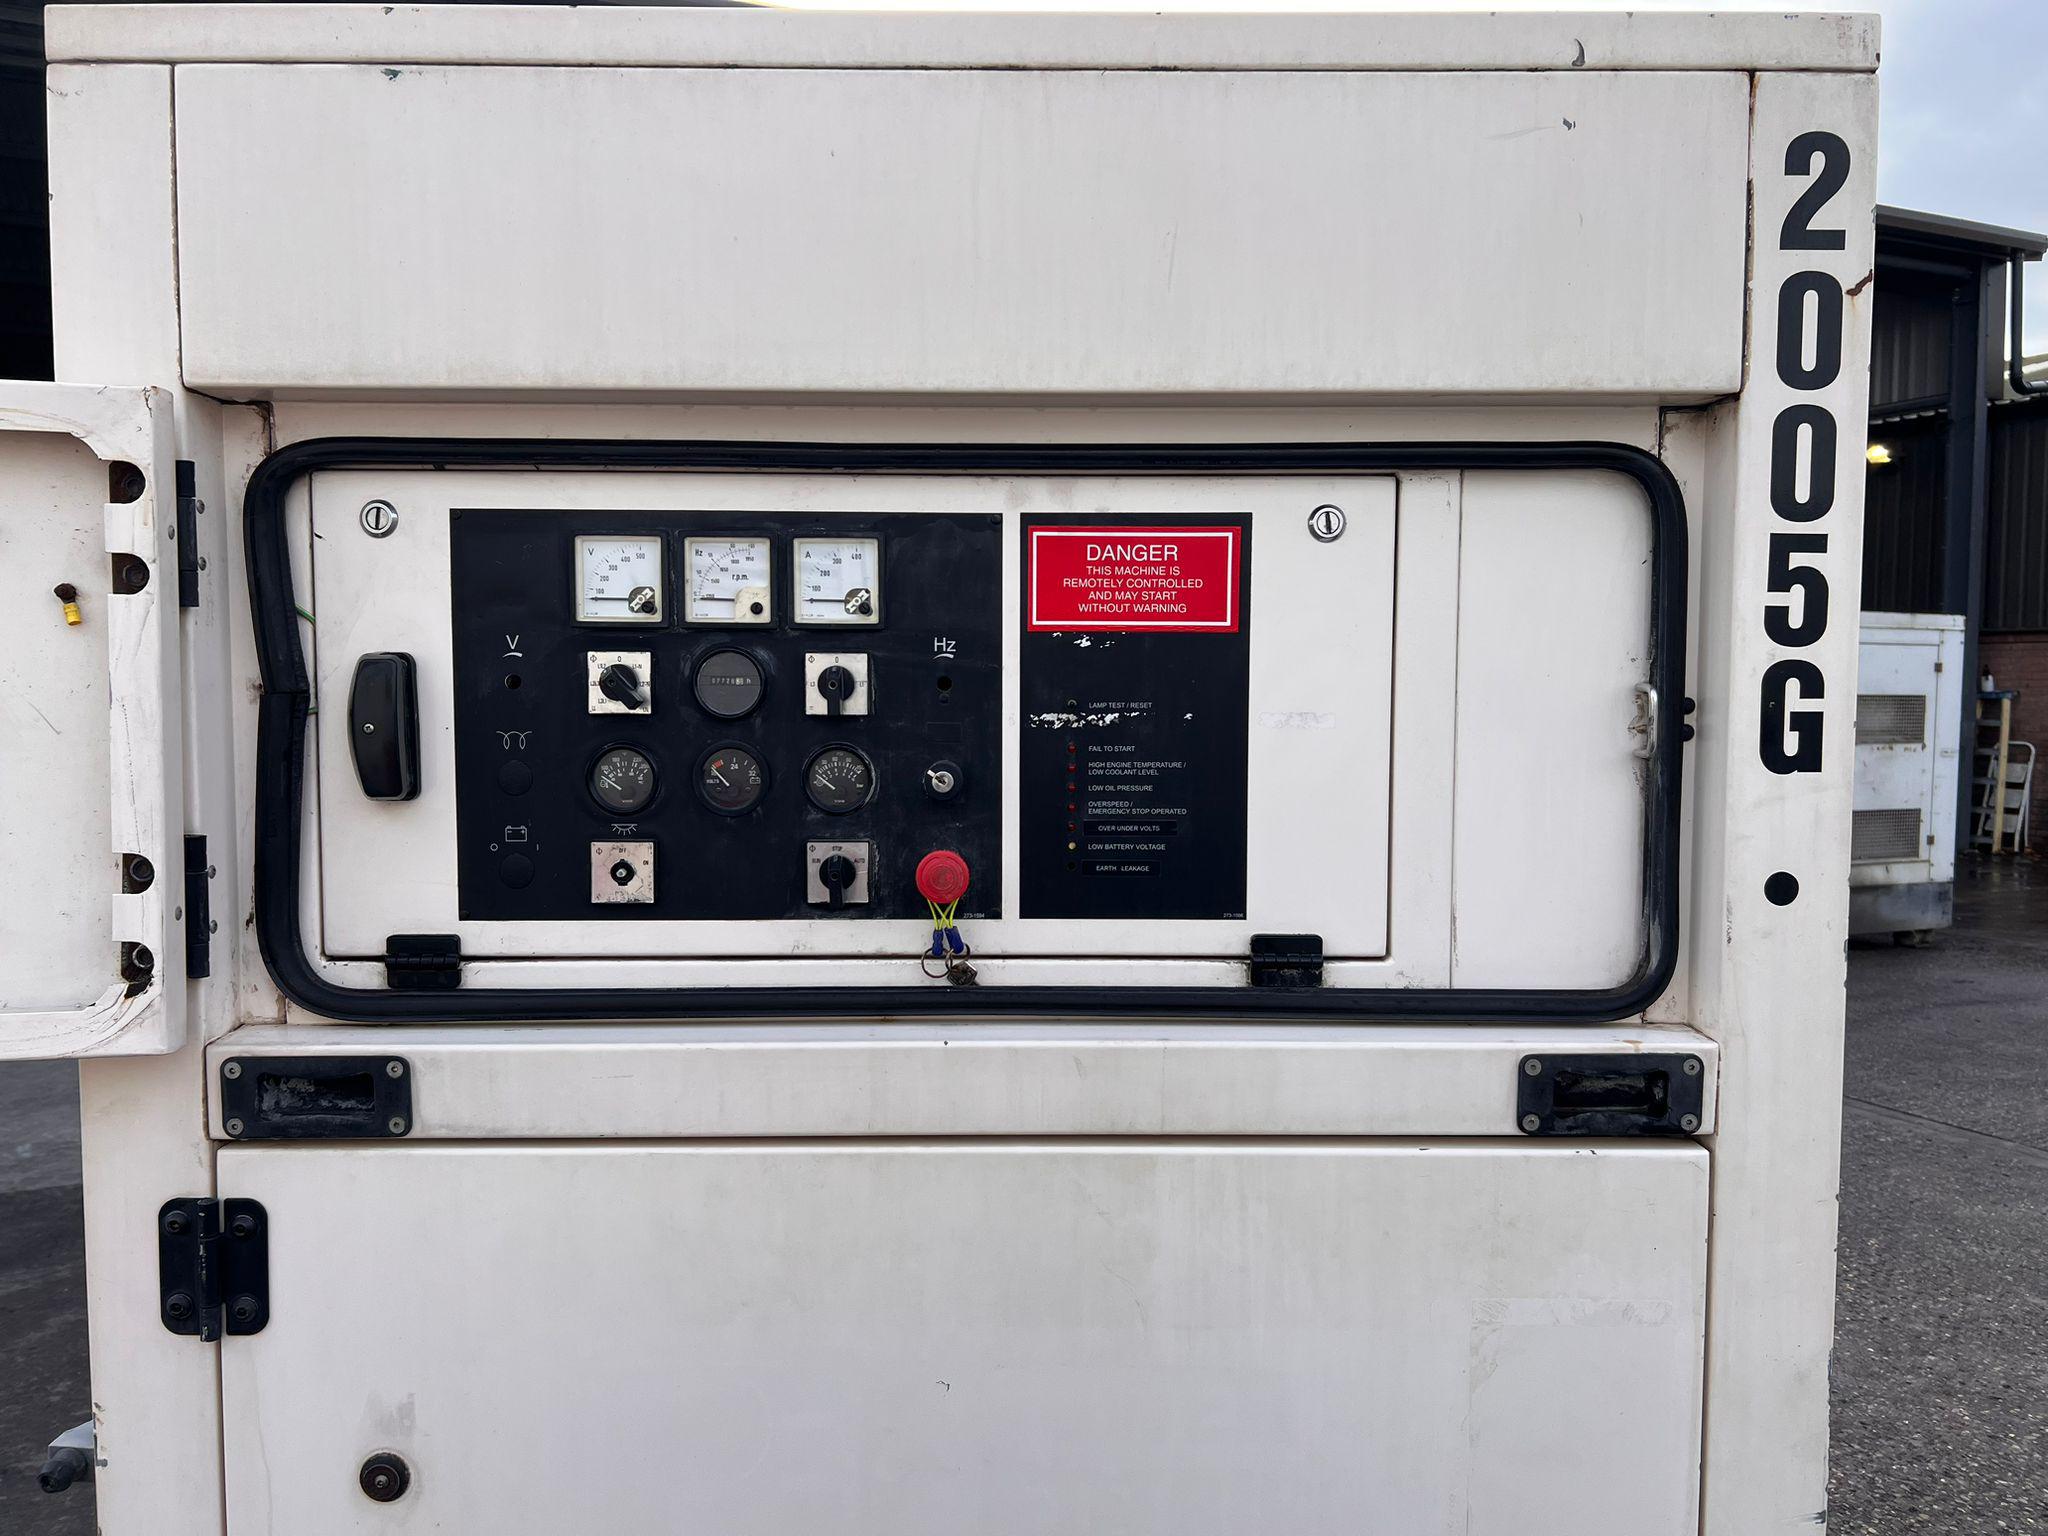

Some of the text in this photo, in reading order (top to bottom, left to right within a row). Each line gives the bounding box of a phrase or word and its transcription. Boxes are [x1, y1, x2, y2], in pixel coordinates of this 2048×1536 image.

[1759, 131, 1851, 775] 2005G
[588, 547, 595, 556] V
[635, 552, 646, 560] 500
[694, 548, 703, 557] Hz
[804, 551, 812, 559] A
[1086, 544, 1178, 562] DANGER
[820, 569, 831, 577] 200
[1086, 565, 1181, 576] THIS MACHINE IS
[731, 573, 750, 582] r.p.m.
[1063, 578, 1203, 589] REMOTELY CONTROLLED
[595, 587, 605, 595] 100
[1088, 590, 1178, 601] AND MAY START
[1078, 603, 1187, 613] WITHOUT WARNING
[505, 634, 520, 650] V
[934, 637, 957, 652] Hz
[1134, 761, 1183, 769] TEMPERATURE
